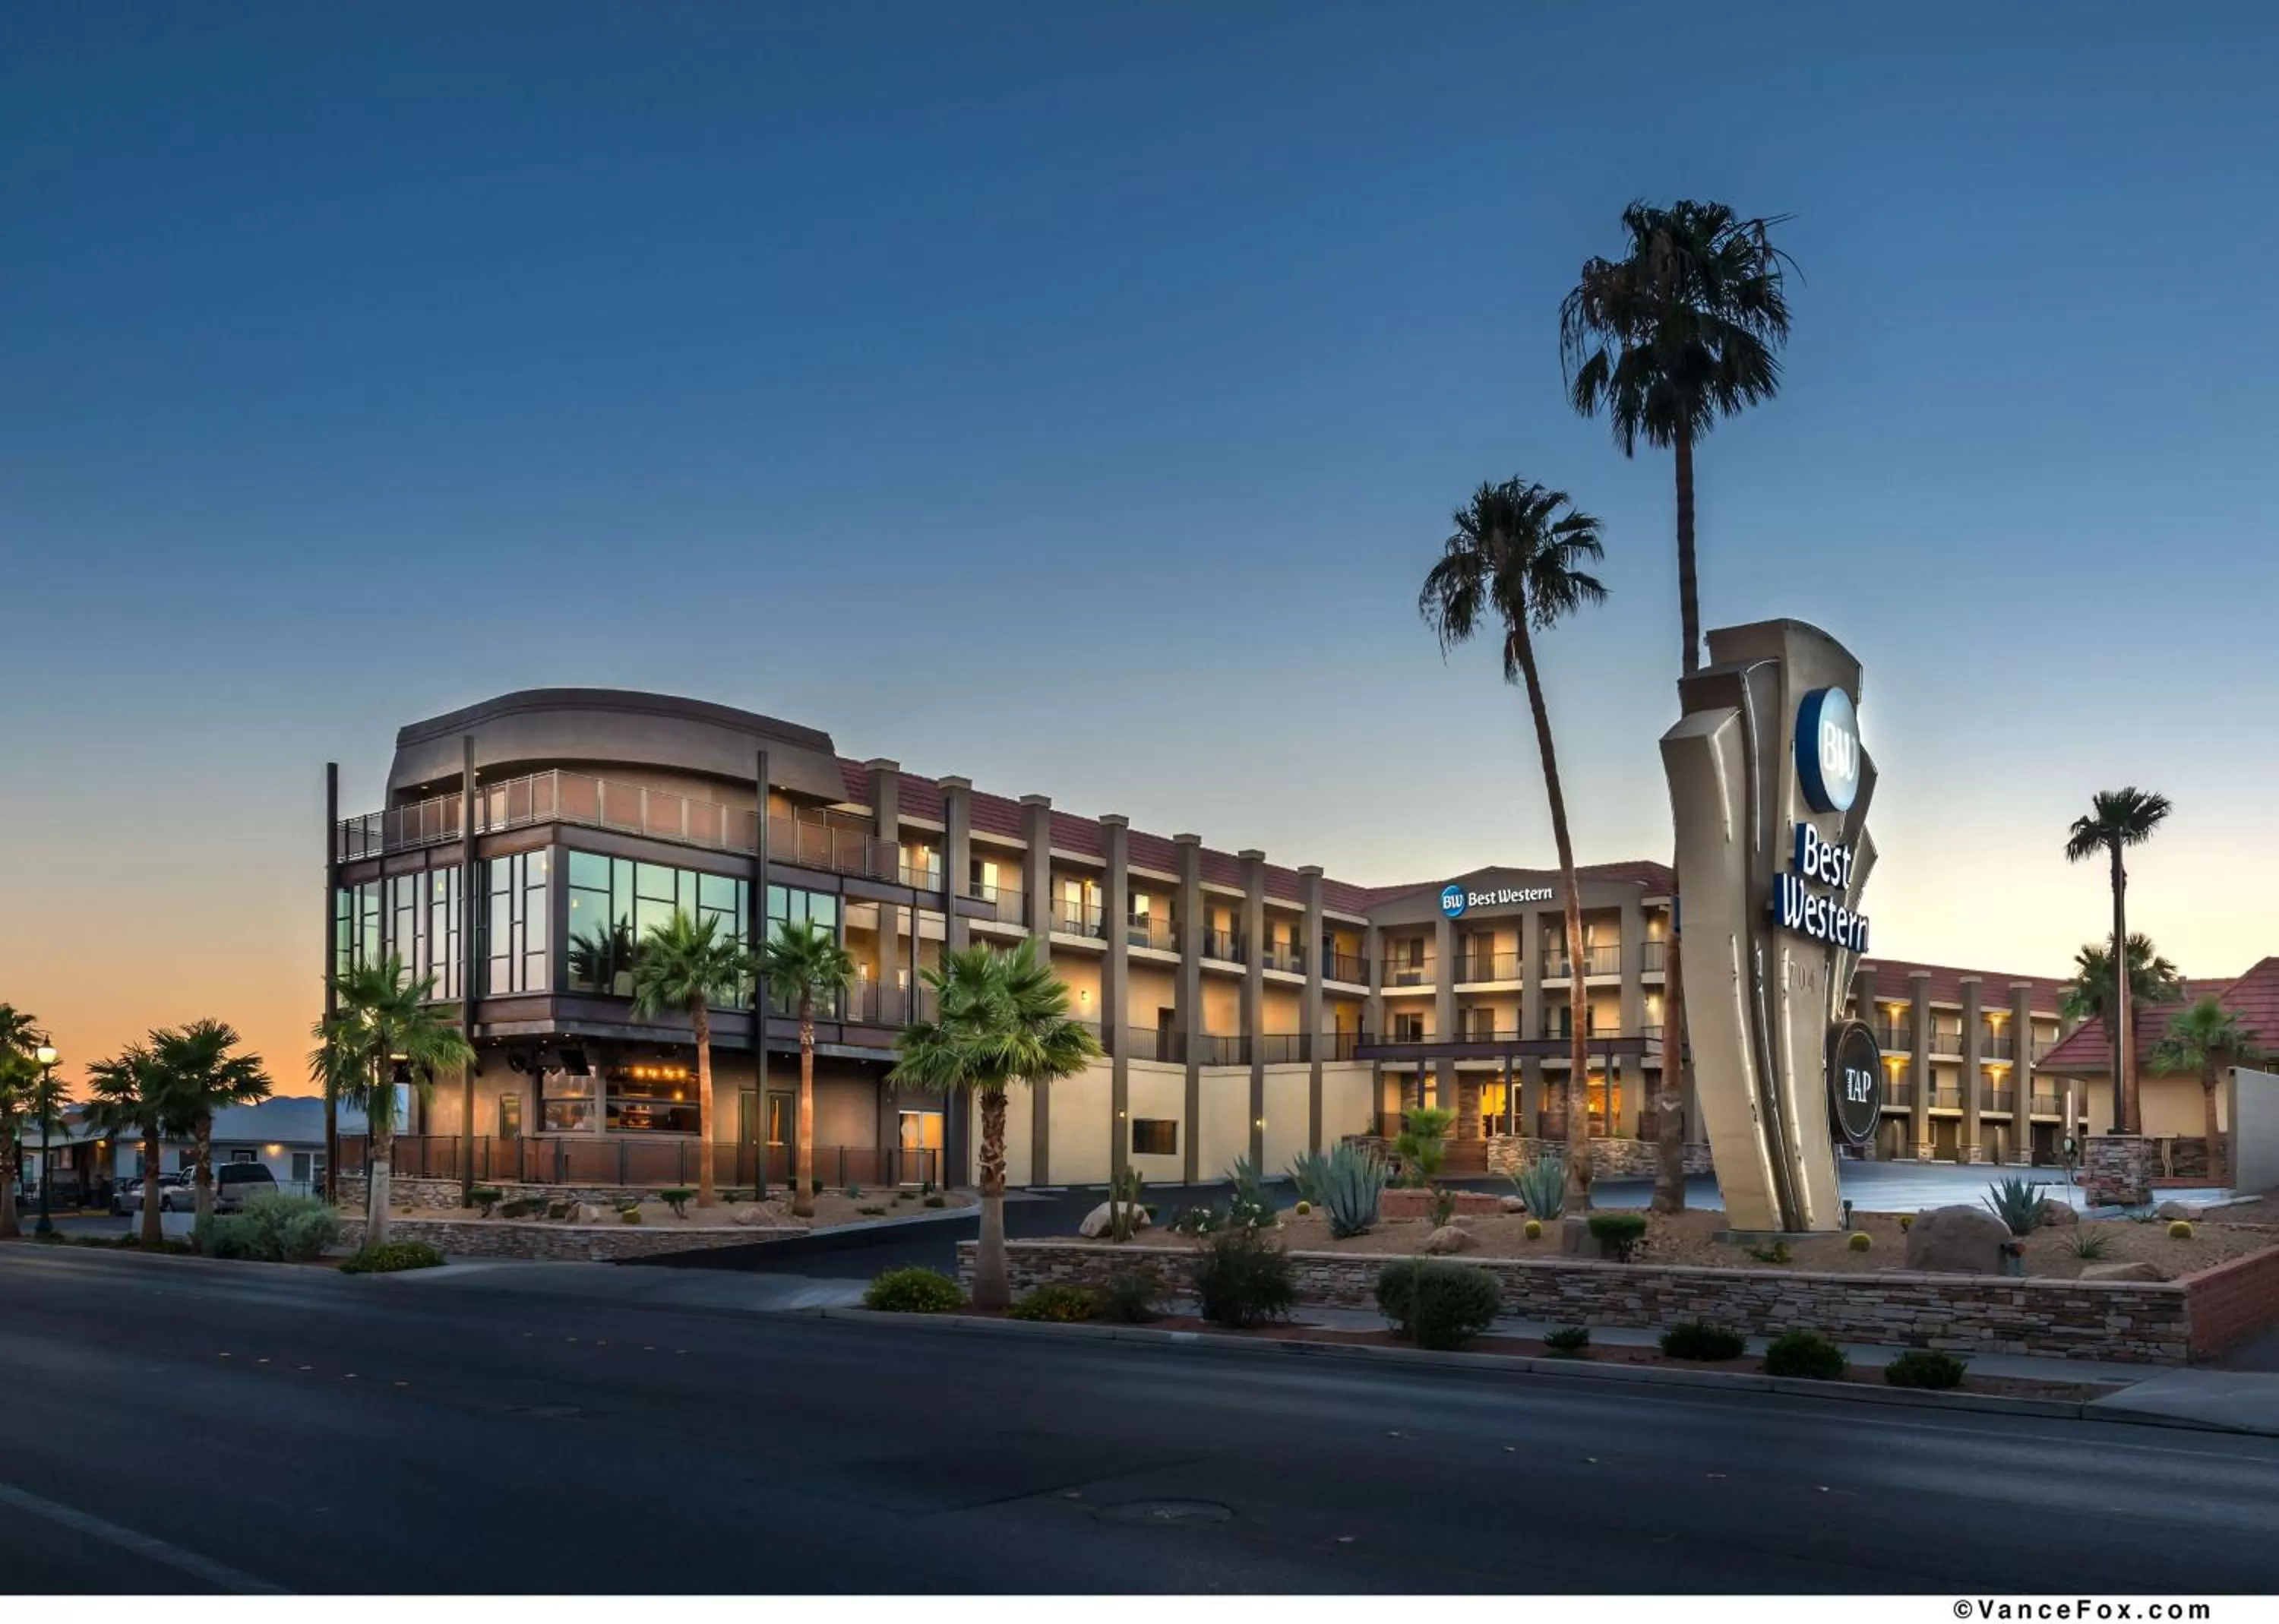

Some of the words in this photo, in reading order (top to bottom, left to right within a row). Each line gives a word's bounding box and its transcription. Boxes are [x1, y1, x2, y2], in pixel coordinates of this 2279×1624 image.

[1823, 720, 1857, 781] BW
[1803, 823, 1851, 889] Best
[1443, 895, 1464, 909] BW
[1468, 892, 1497, 906] Best
[1499, 887, 1553, 903] Western
[1783, 873, 1870, 951] Western
[1846, 1067, 1871, 1102] TAP
